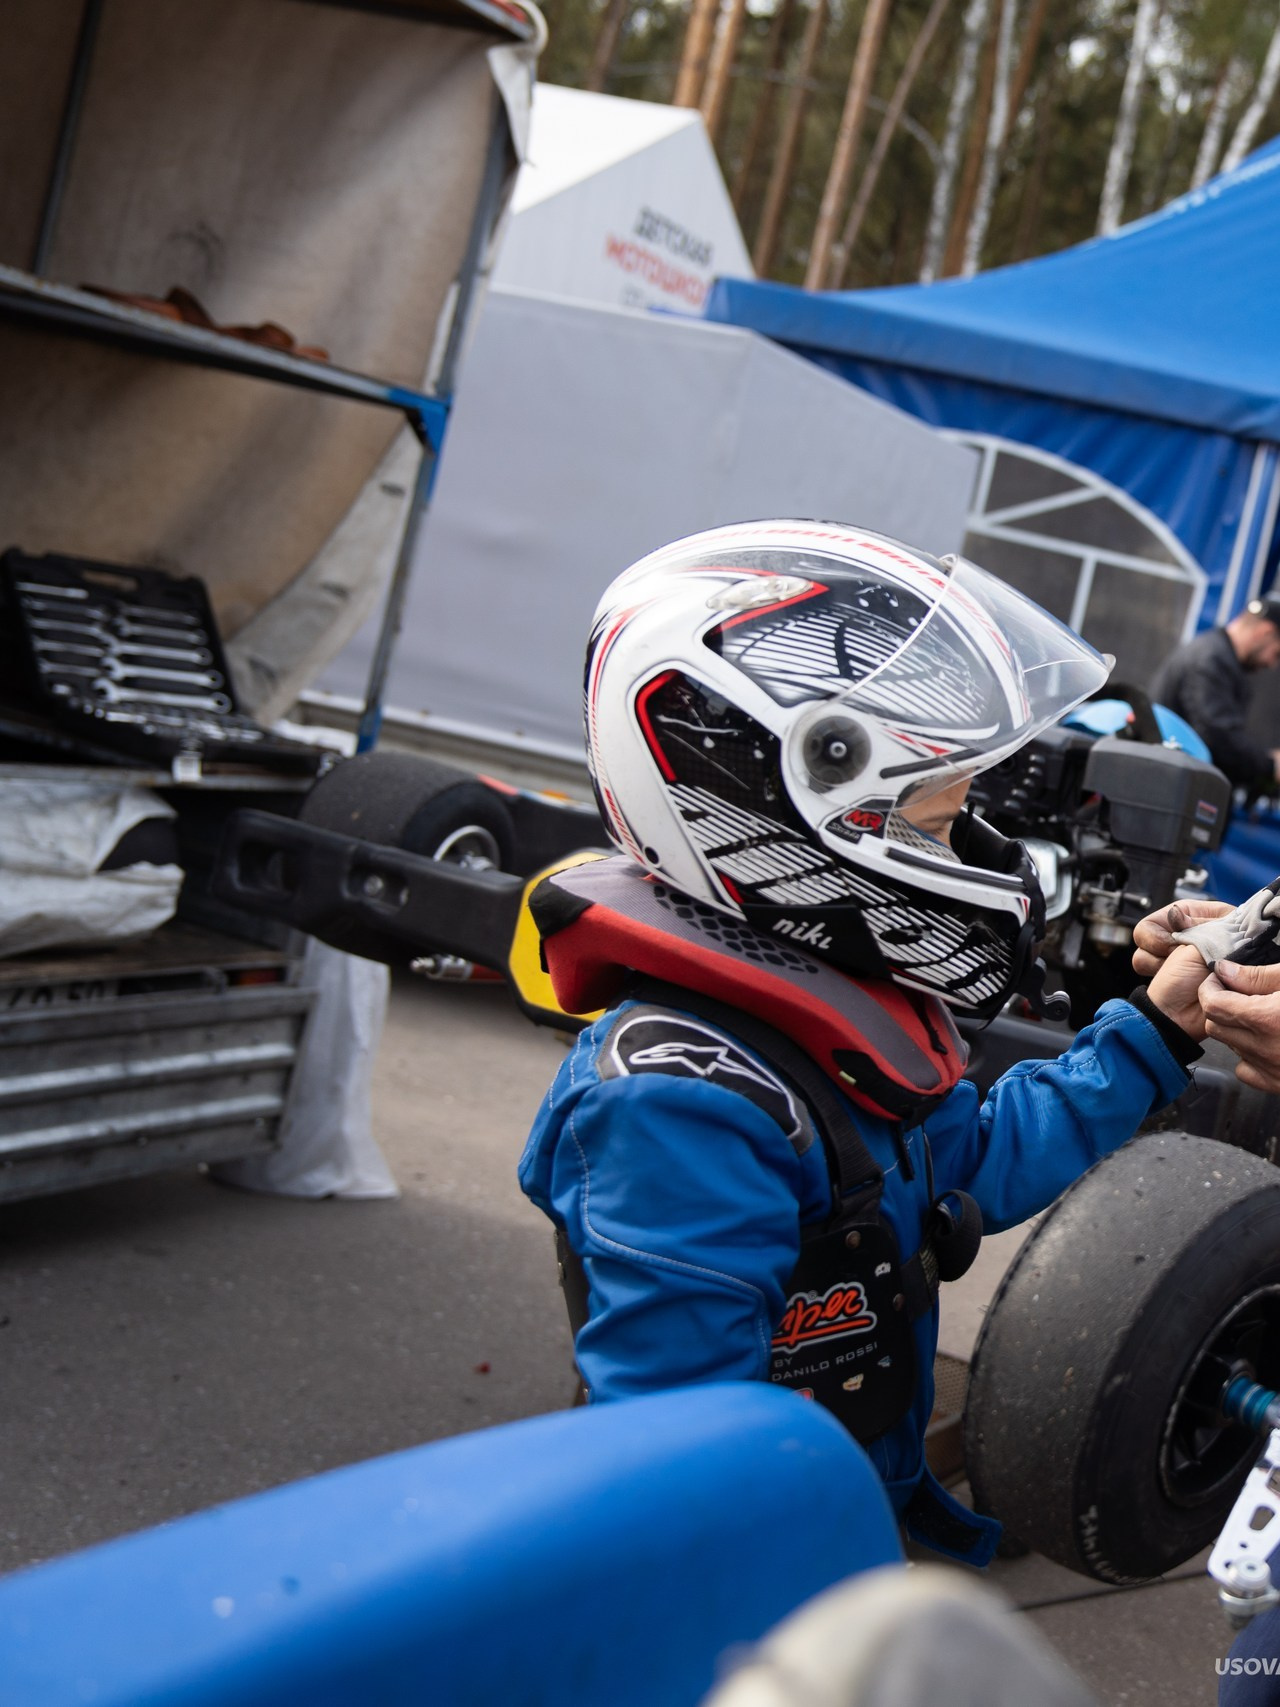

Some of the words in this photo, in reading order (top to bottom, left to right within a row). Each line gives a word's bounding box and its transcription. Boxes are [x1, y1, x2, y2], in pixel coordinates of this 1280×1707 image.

[772, 1360, 830, 1382] DANILO
[835, 1341, 878, 1365] ROSSI
[774, 1356, 793, 1368] BY
